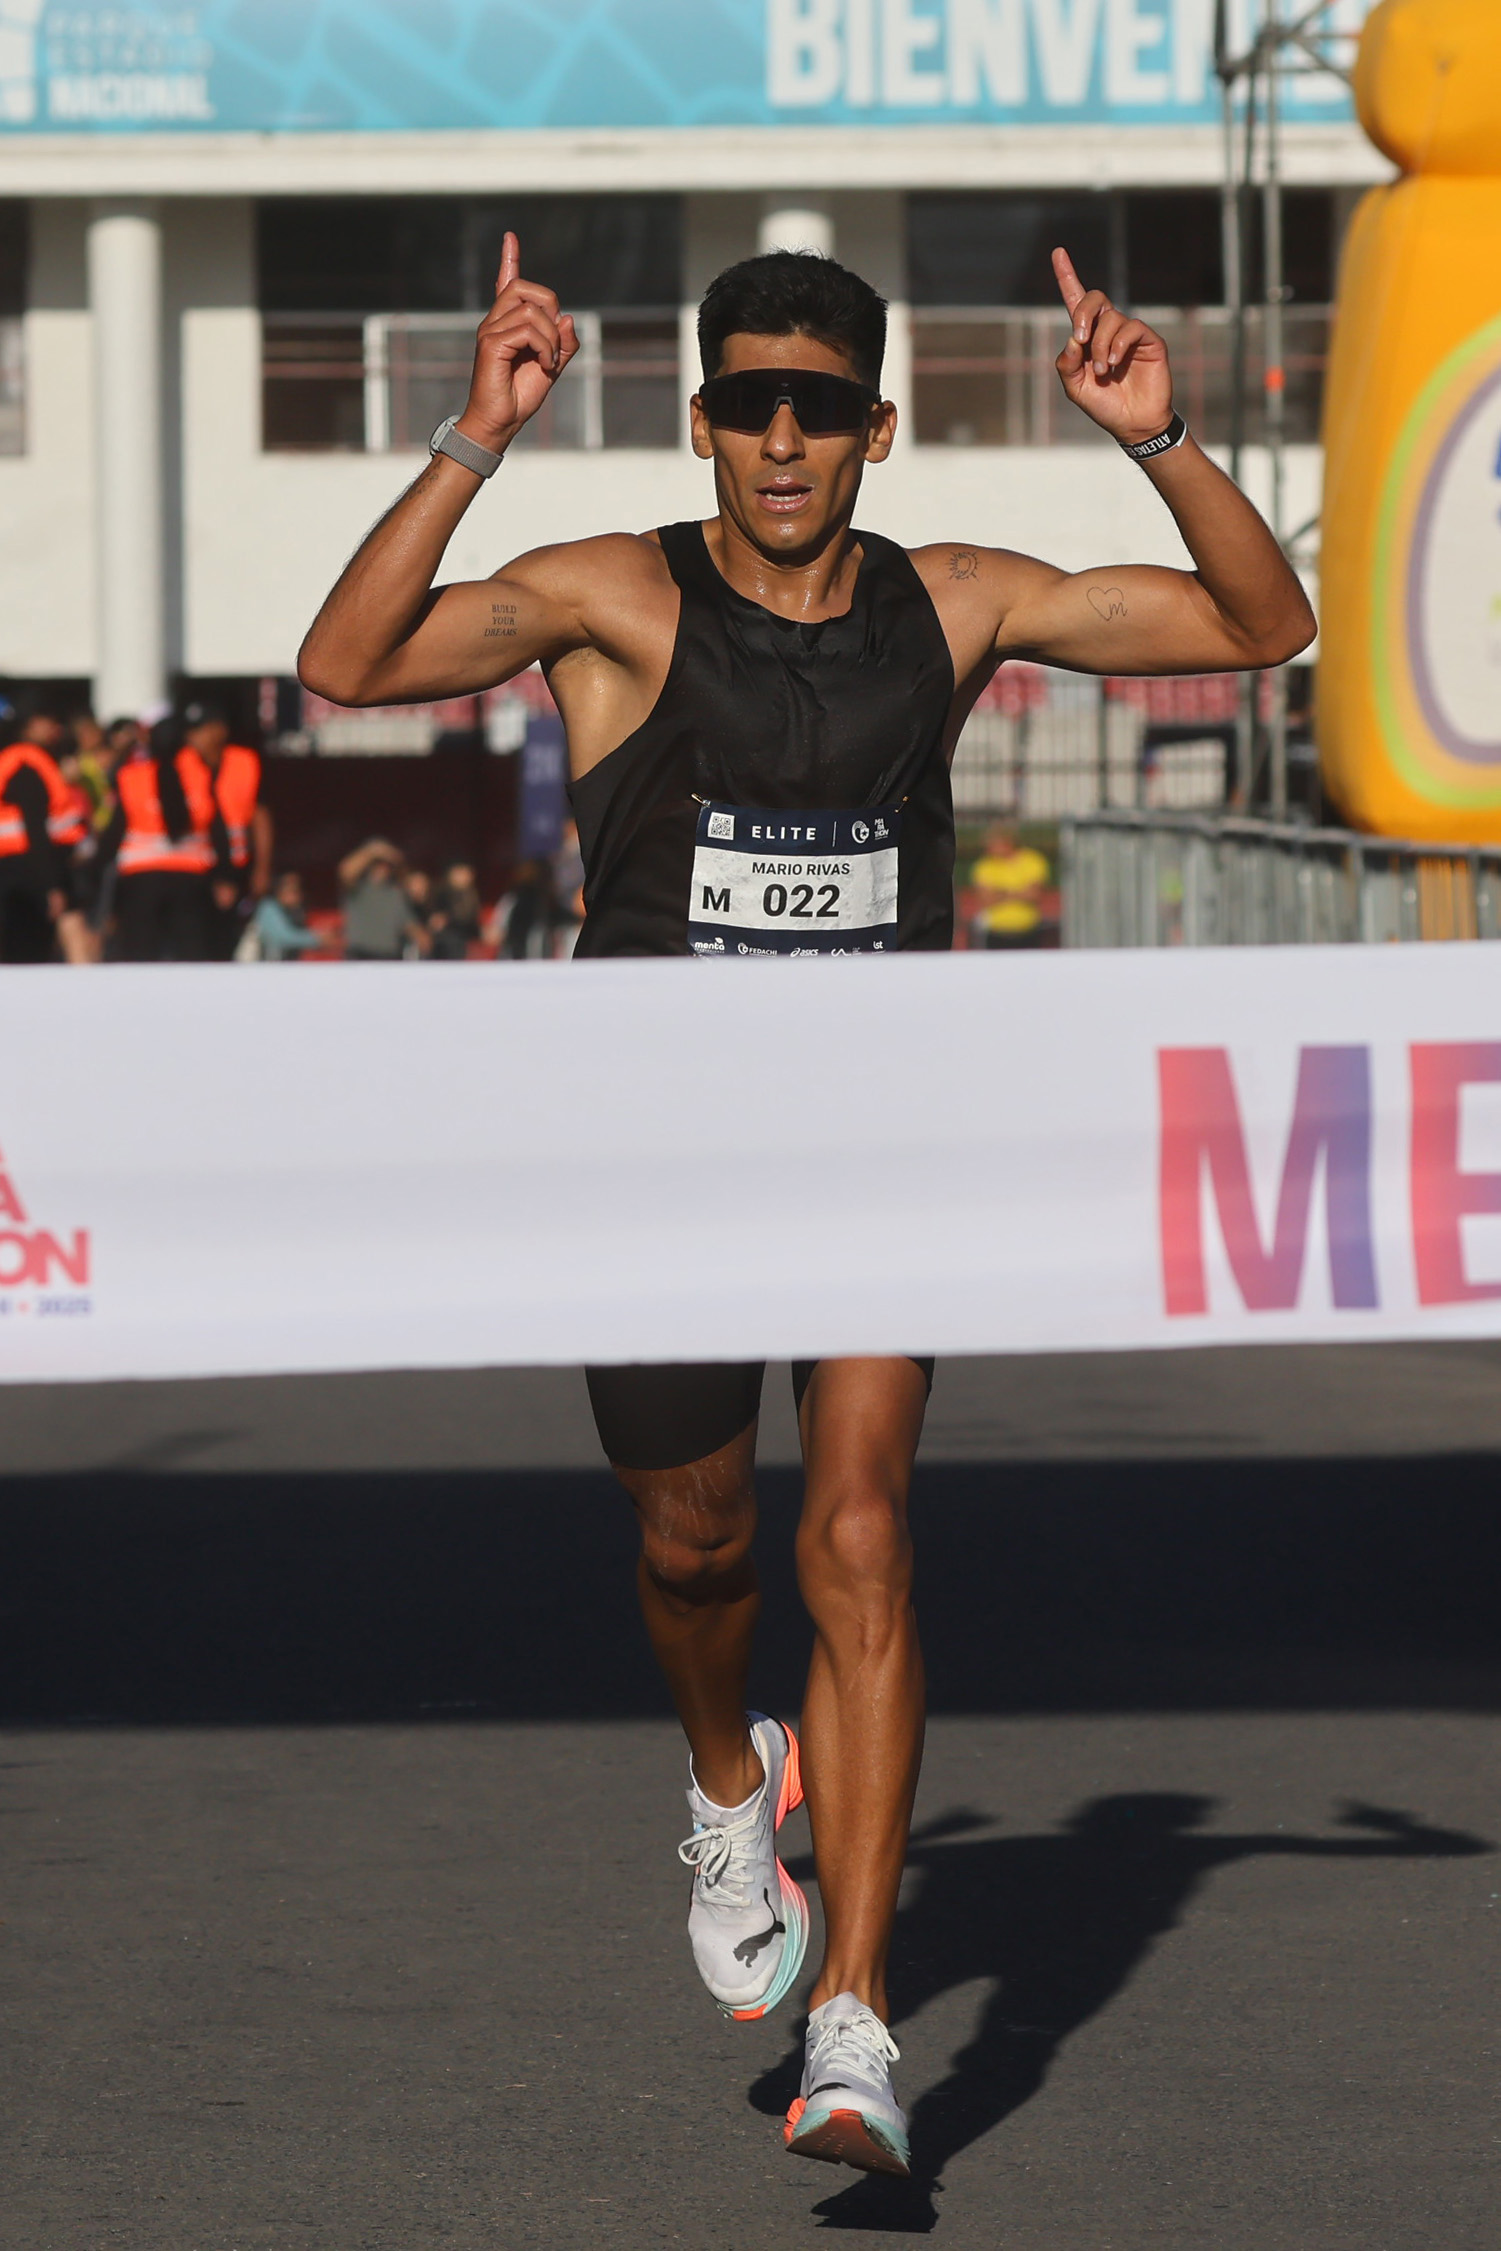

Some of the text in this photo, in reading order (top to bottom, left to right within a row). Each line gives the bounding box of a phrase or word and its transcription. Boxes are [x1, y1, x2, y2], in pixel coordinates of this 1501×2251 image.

[1134, 433, 1171, 456] ATLETAS
[492, 604, 517, 613] BUILD
[492, 616, 515, 625] YOUR
[484, 628, 518, 636] DREAMS
[752, 825, 816, 841] ELITE
[752, 862, 850, 876] MARIO RIVAS
[702, 883, 840, 918] M 022
